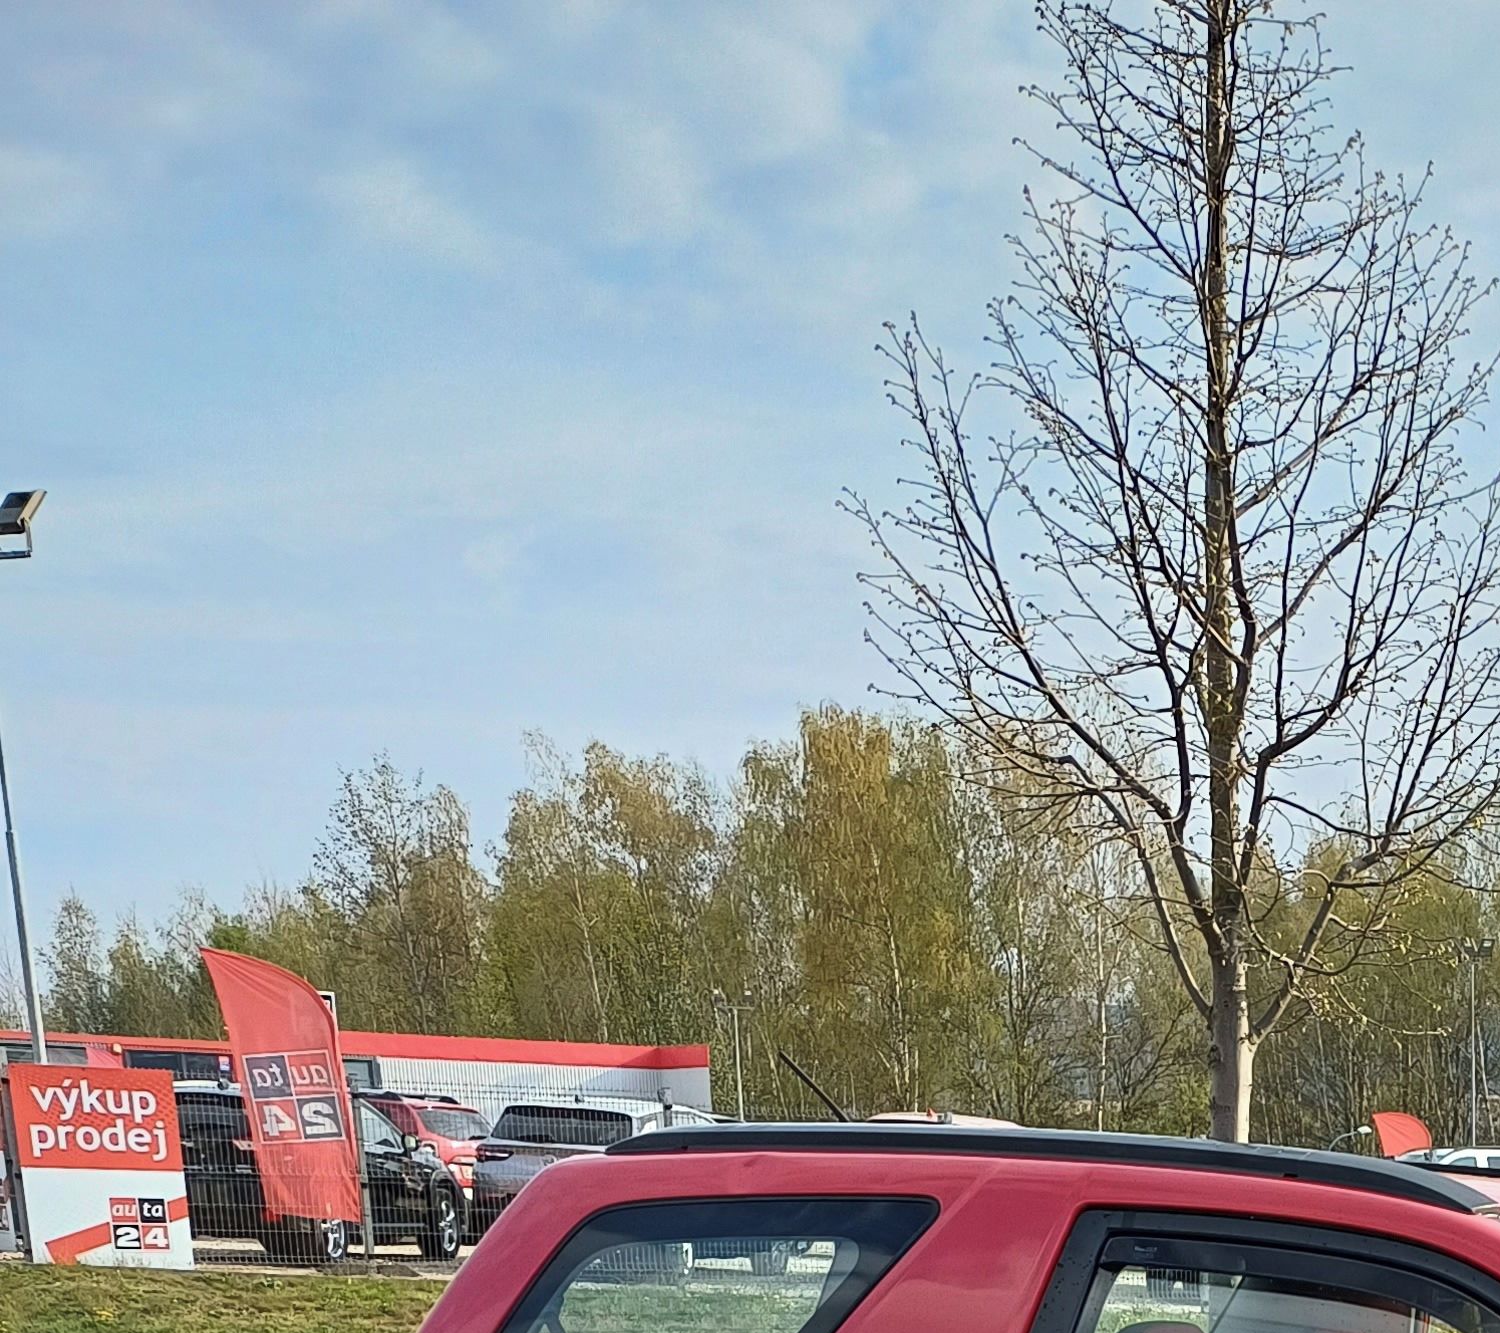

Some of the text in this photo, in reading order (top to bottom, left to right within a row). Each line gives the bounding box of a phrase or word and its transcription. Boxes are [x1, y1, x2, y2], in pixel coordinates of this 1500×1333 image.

[29, 1078, 157, 1124] výkup
[29, 1118, 168, 1161] prodej
[112, 1202, 163, 1217] auta
[115, 1226, 168, 1248] 24
